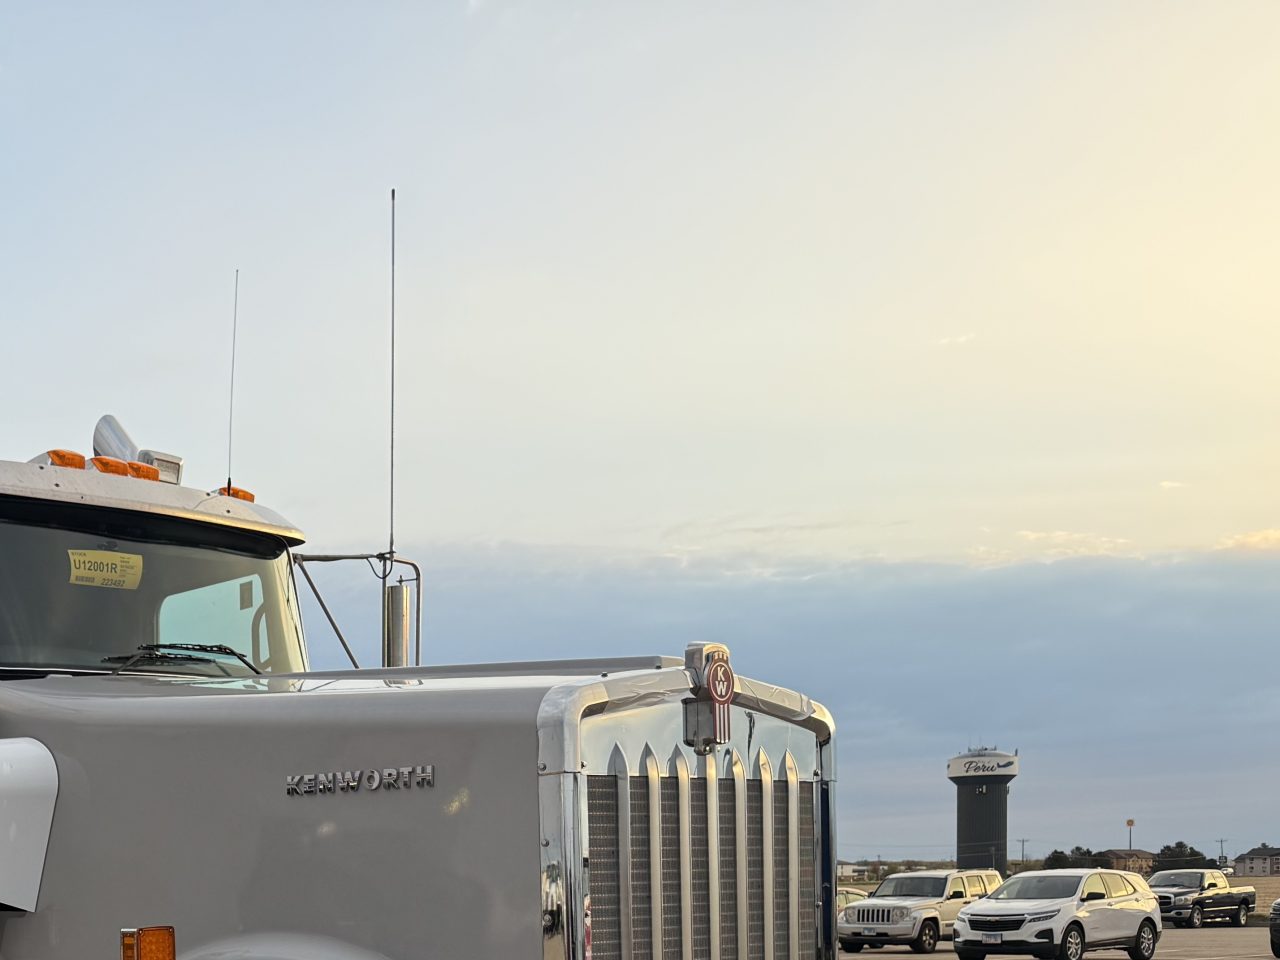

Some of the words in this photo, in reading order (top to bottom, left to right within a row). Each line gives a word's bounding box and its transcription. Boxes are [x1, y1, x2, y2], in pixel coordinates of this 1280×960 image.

[74, 559, 118, 574] U12001R
[964, 761, 997, 774] Peru
[286, 765, 435, 796] KENWORTH
